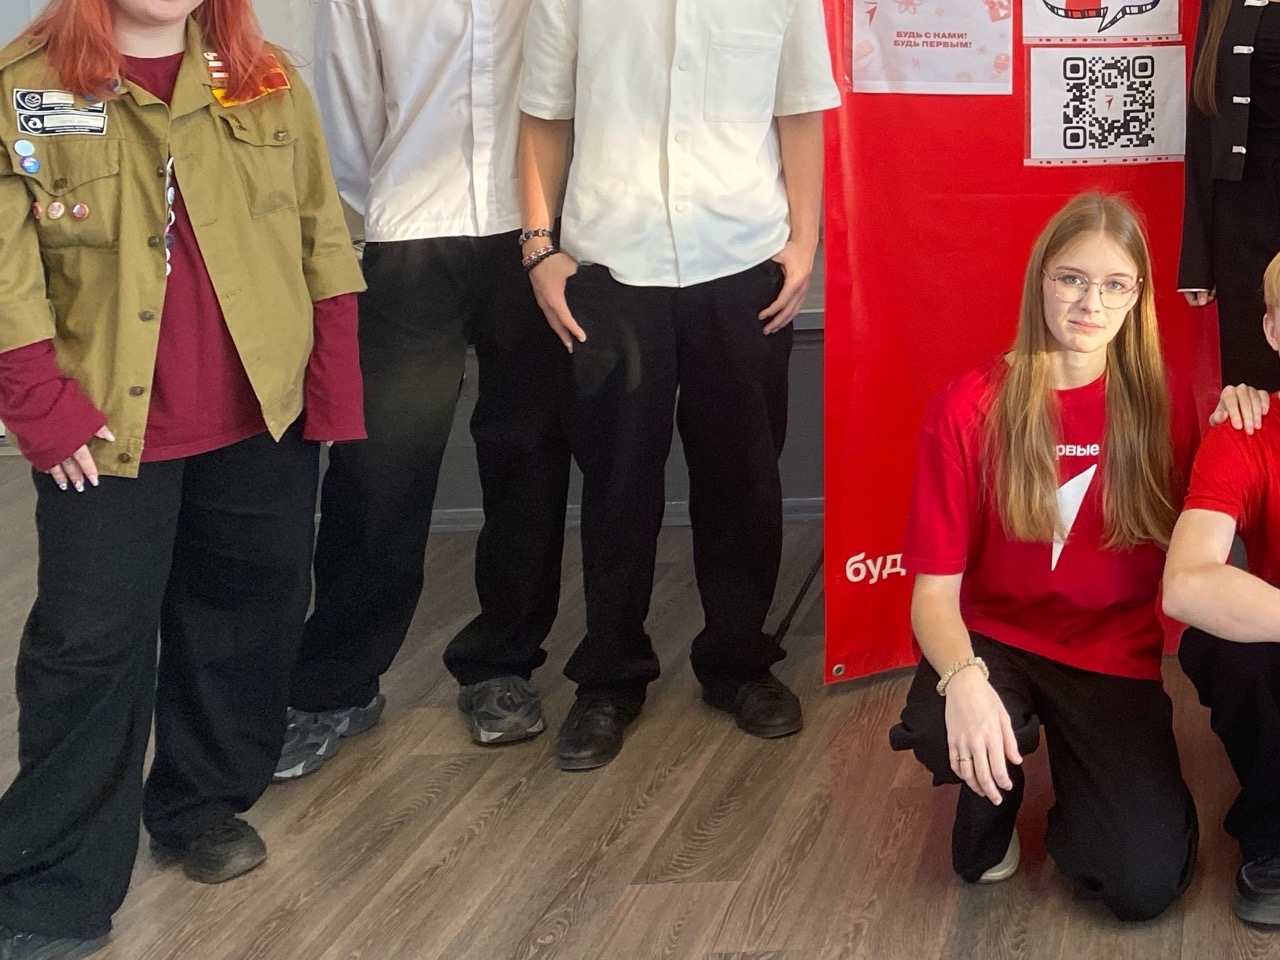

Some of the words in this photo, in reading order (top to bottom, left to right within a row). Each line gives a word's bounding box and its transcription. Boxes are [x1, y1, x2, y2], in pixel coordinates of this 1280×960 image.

[896, 31, 922, 39] БУДЬ
[893, 40, 920, 48] БУДЬ
[922, 40, 972, 48] ПЕРВЫМ!
[1055, 444, 1100, 460] рвые
[845, 552, 906, 584] буд
